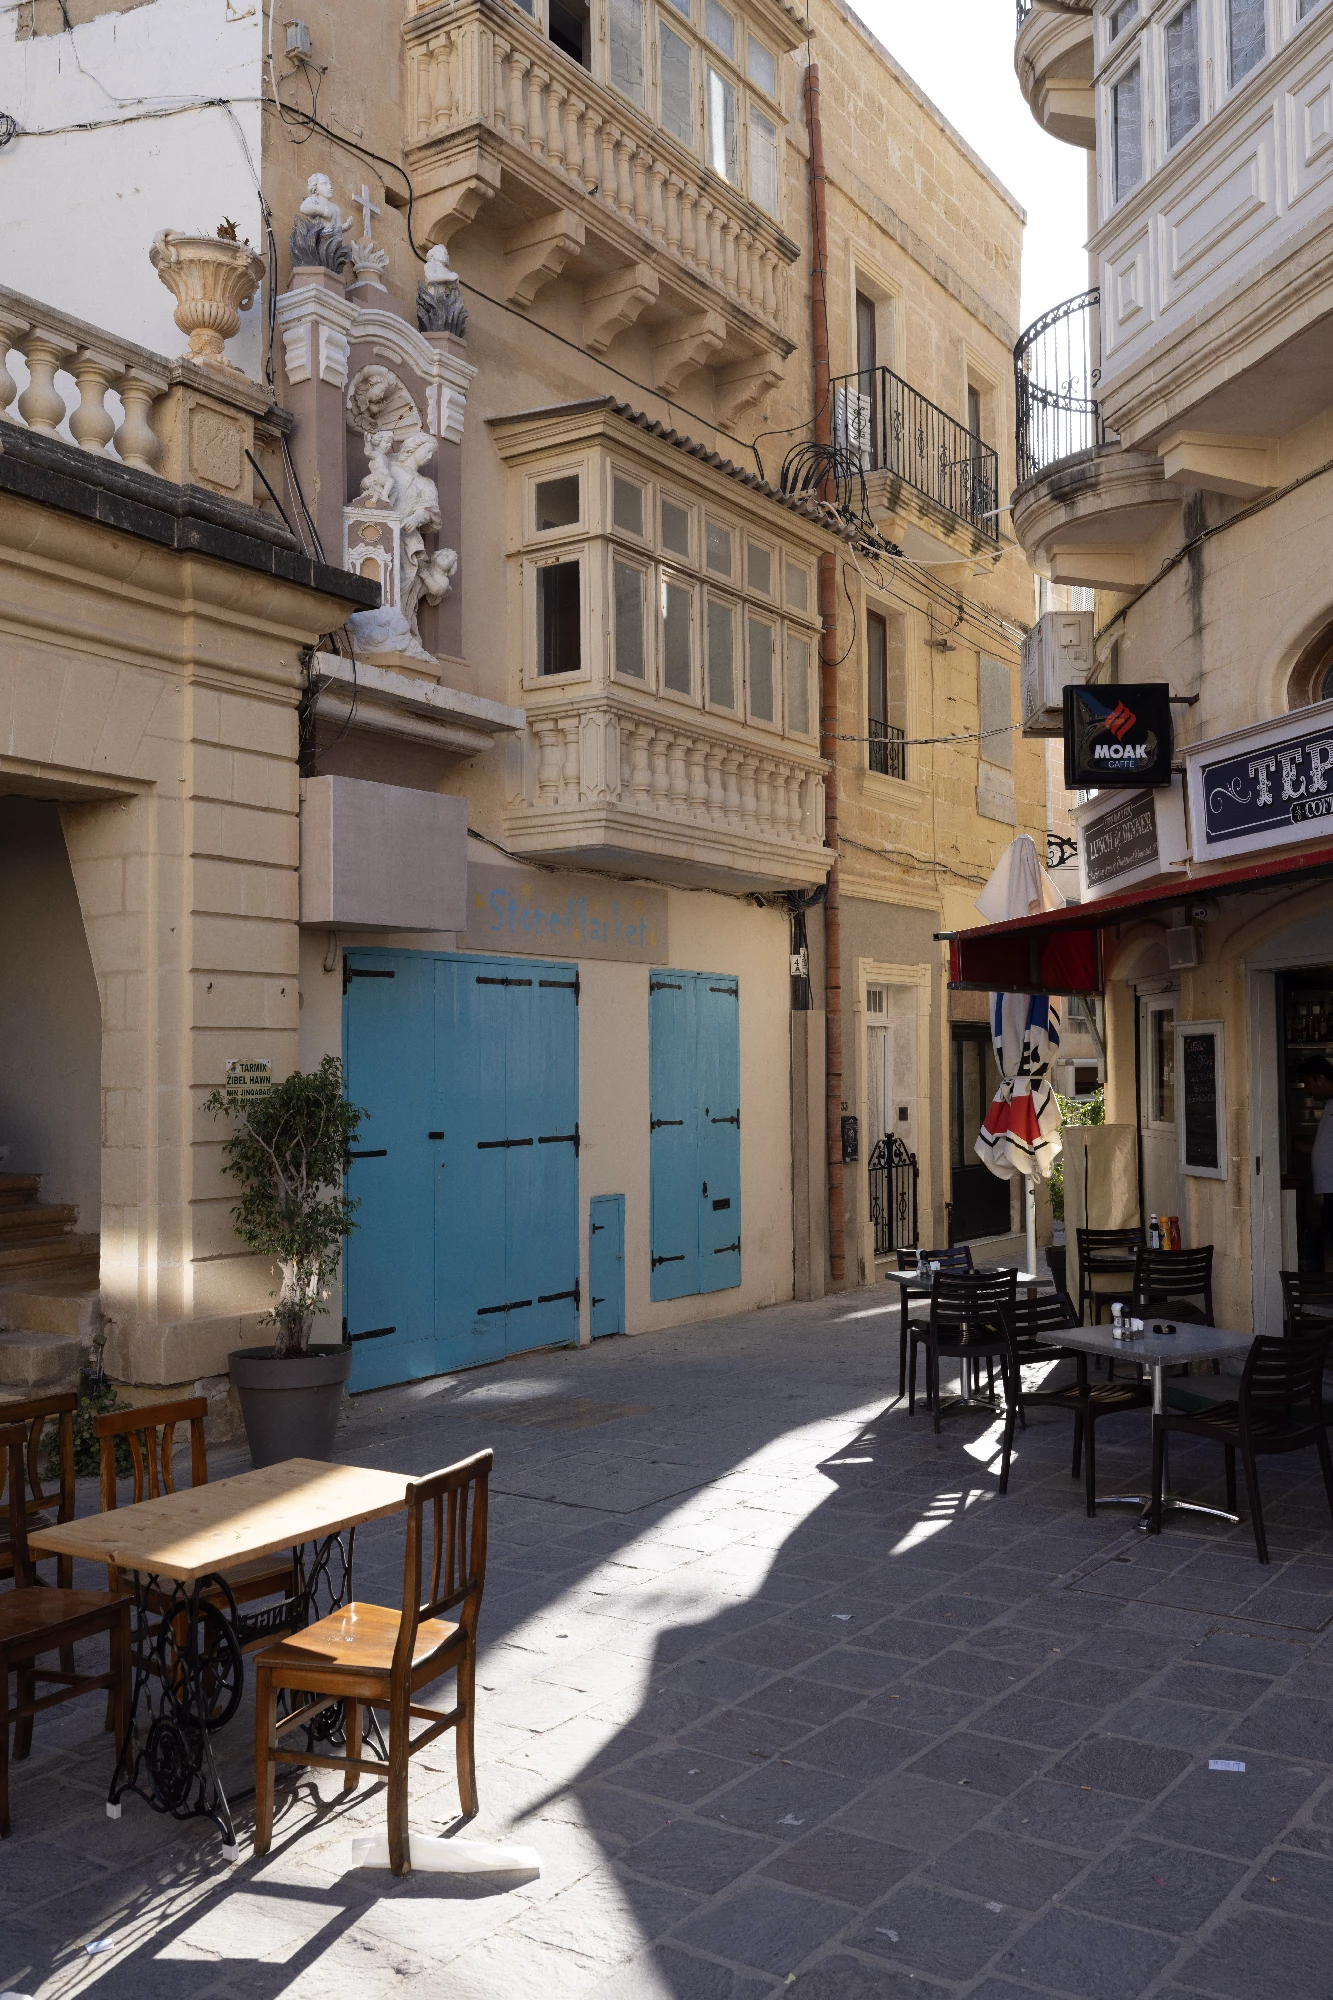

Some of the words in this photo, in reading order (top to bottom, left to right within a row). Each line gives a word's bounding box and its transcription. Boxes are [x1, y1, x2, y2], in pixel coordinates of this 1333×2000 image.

[1095, 744, 1148, 759] MOAK
[240, 1063, 267, 1072] TARMIX
[249, 1075, 270, 1085] HAWN
